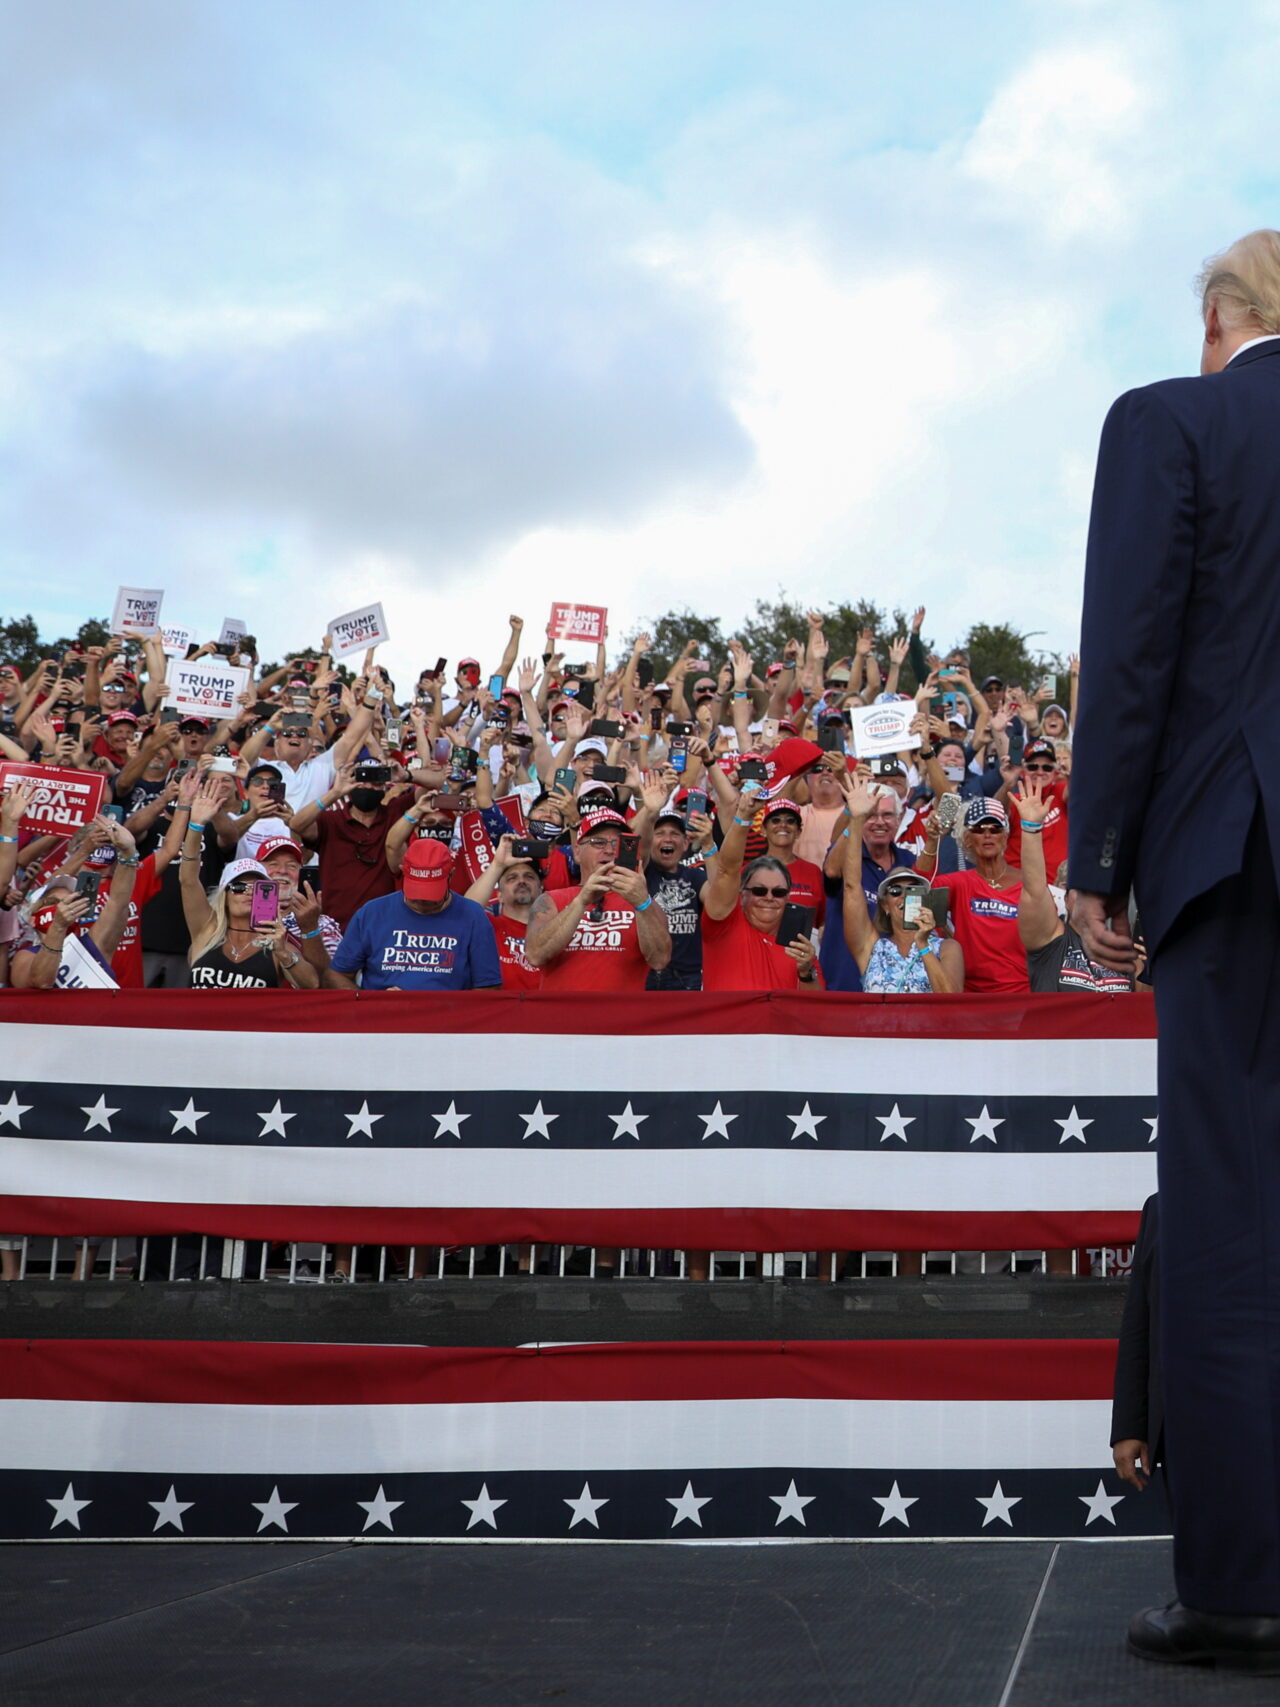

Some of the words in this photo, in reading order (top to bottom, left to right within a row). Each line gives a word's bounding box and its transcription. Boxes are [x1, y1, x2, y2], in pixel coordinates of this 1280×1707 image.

[127, 599, 158, 610] TRUMP
[136, 611, 156, 622] VOTE
[556, 609, 600, 621] TRUMP
[334, 614, 375, 634] TRUMP
[347, 622, 379, 640] VOTE
[179, 673, 235, 690] TRUMP
[192, 686, 234, 702] VOTE
[869, 722, 900, 734] TRUMP
[68, 796, 87, 806] THE
[470, 820, 483, 842] TO
[410, 867, 430, 878] TRUMP
[973, 901, 1017, 912] TRUMP
[393, 930, 458, 950] TRUMP
[569, 931, 621, 947] 2020
[382, 947, 440, 965] PENCE
[381, 964, 405, 972] Keeping
[406, 965, 433, 973] America
[1086, 1248, 1133, 1267] TRU
